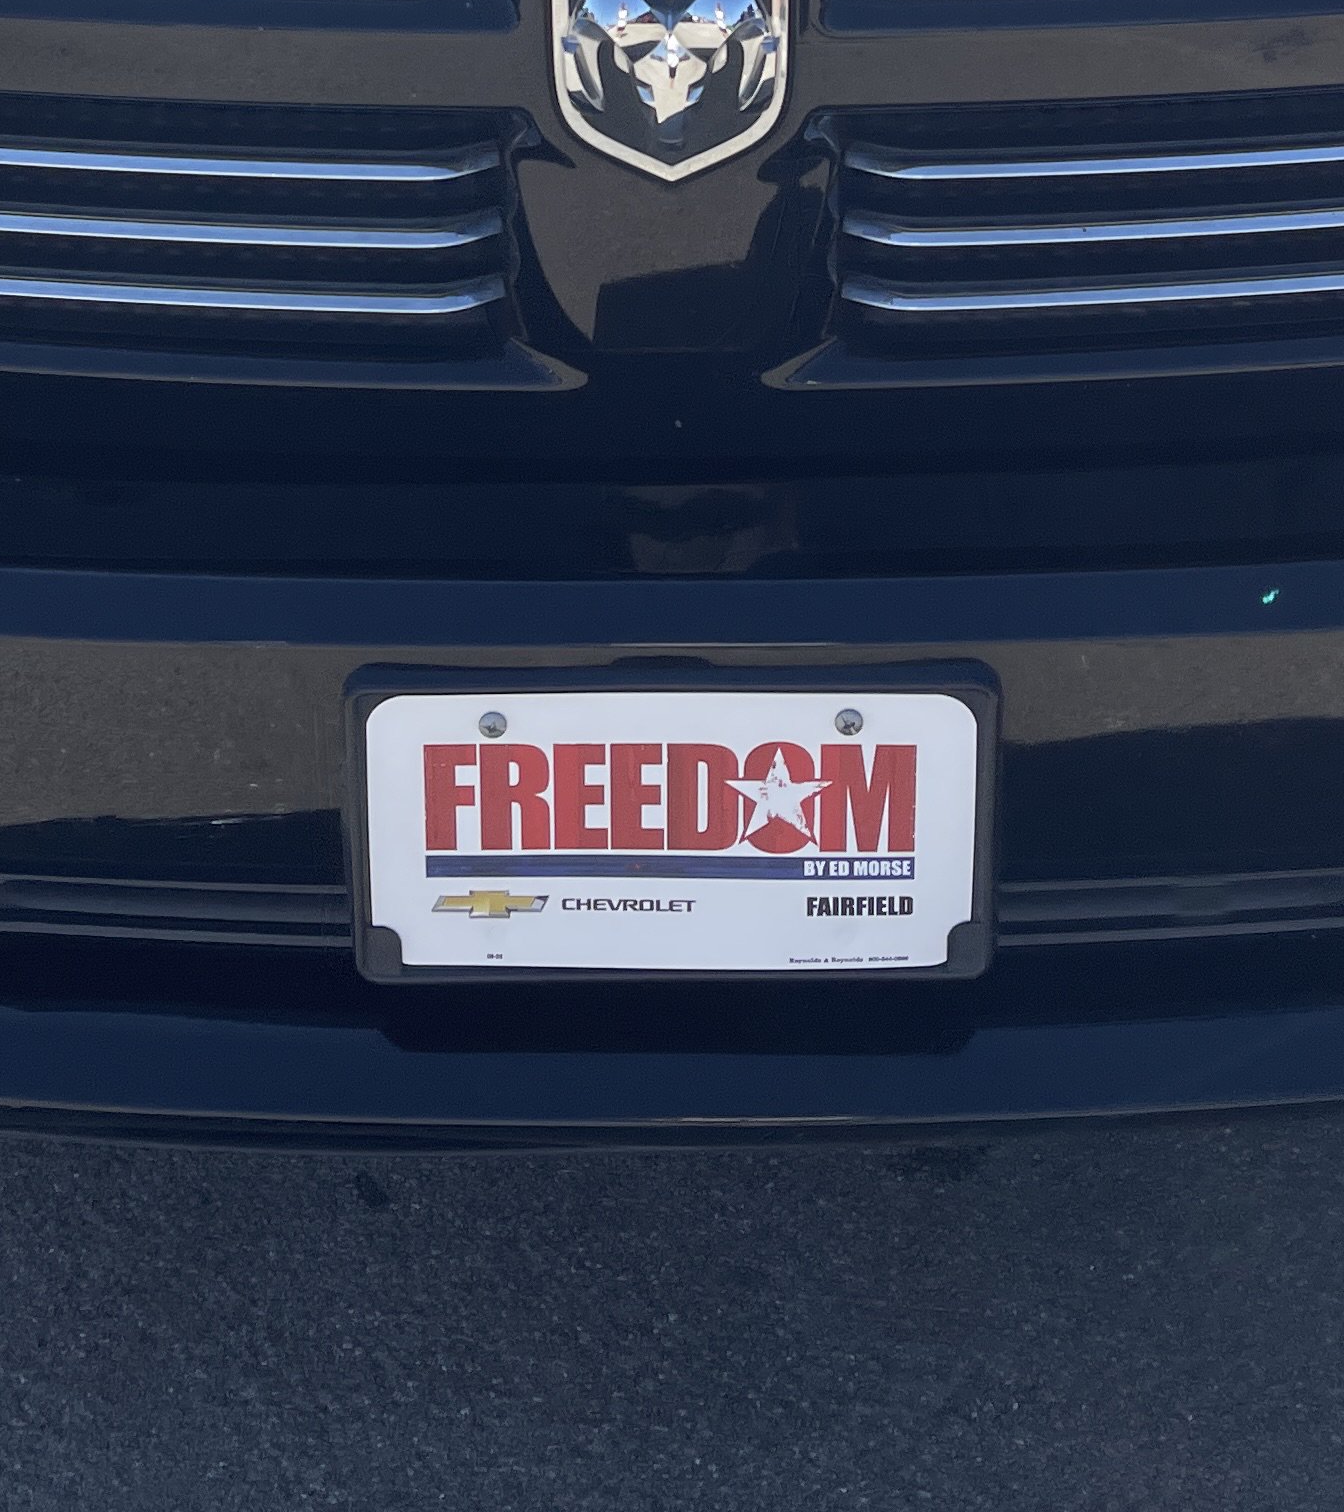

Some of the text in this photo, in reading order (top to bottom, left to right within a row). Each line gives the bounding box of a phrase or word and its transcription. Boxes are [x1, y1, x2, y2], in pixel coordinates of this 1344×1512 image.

[423, 741, 917, 853] FREEDOM
[803, 859, 912, 877] BY ED MORSE
[561, 897, 697, 913] CHEVROLET
[806, 895, 914, 917] FAIRFIELD
